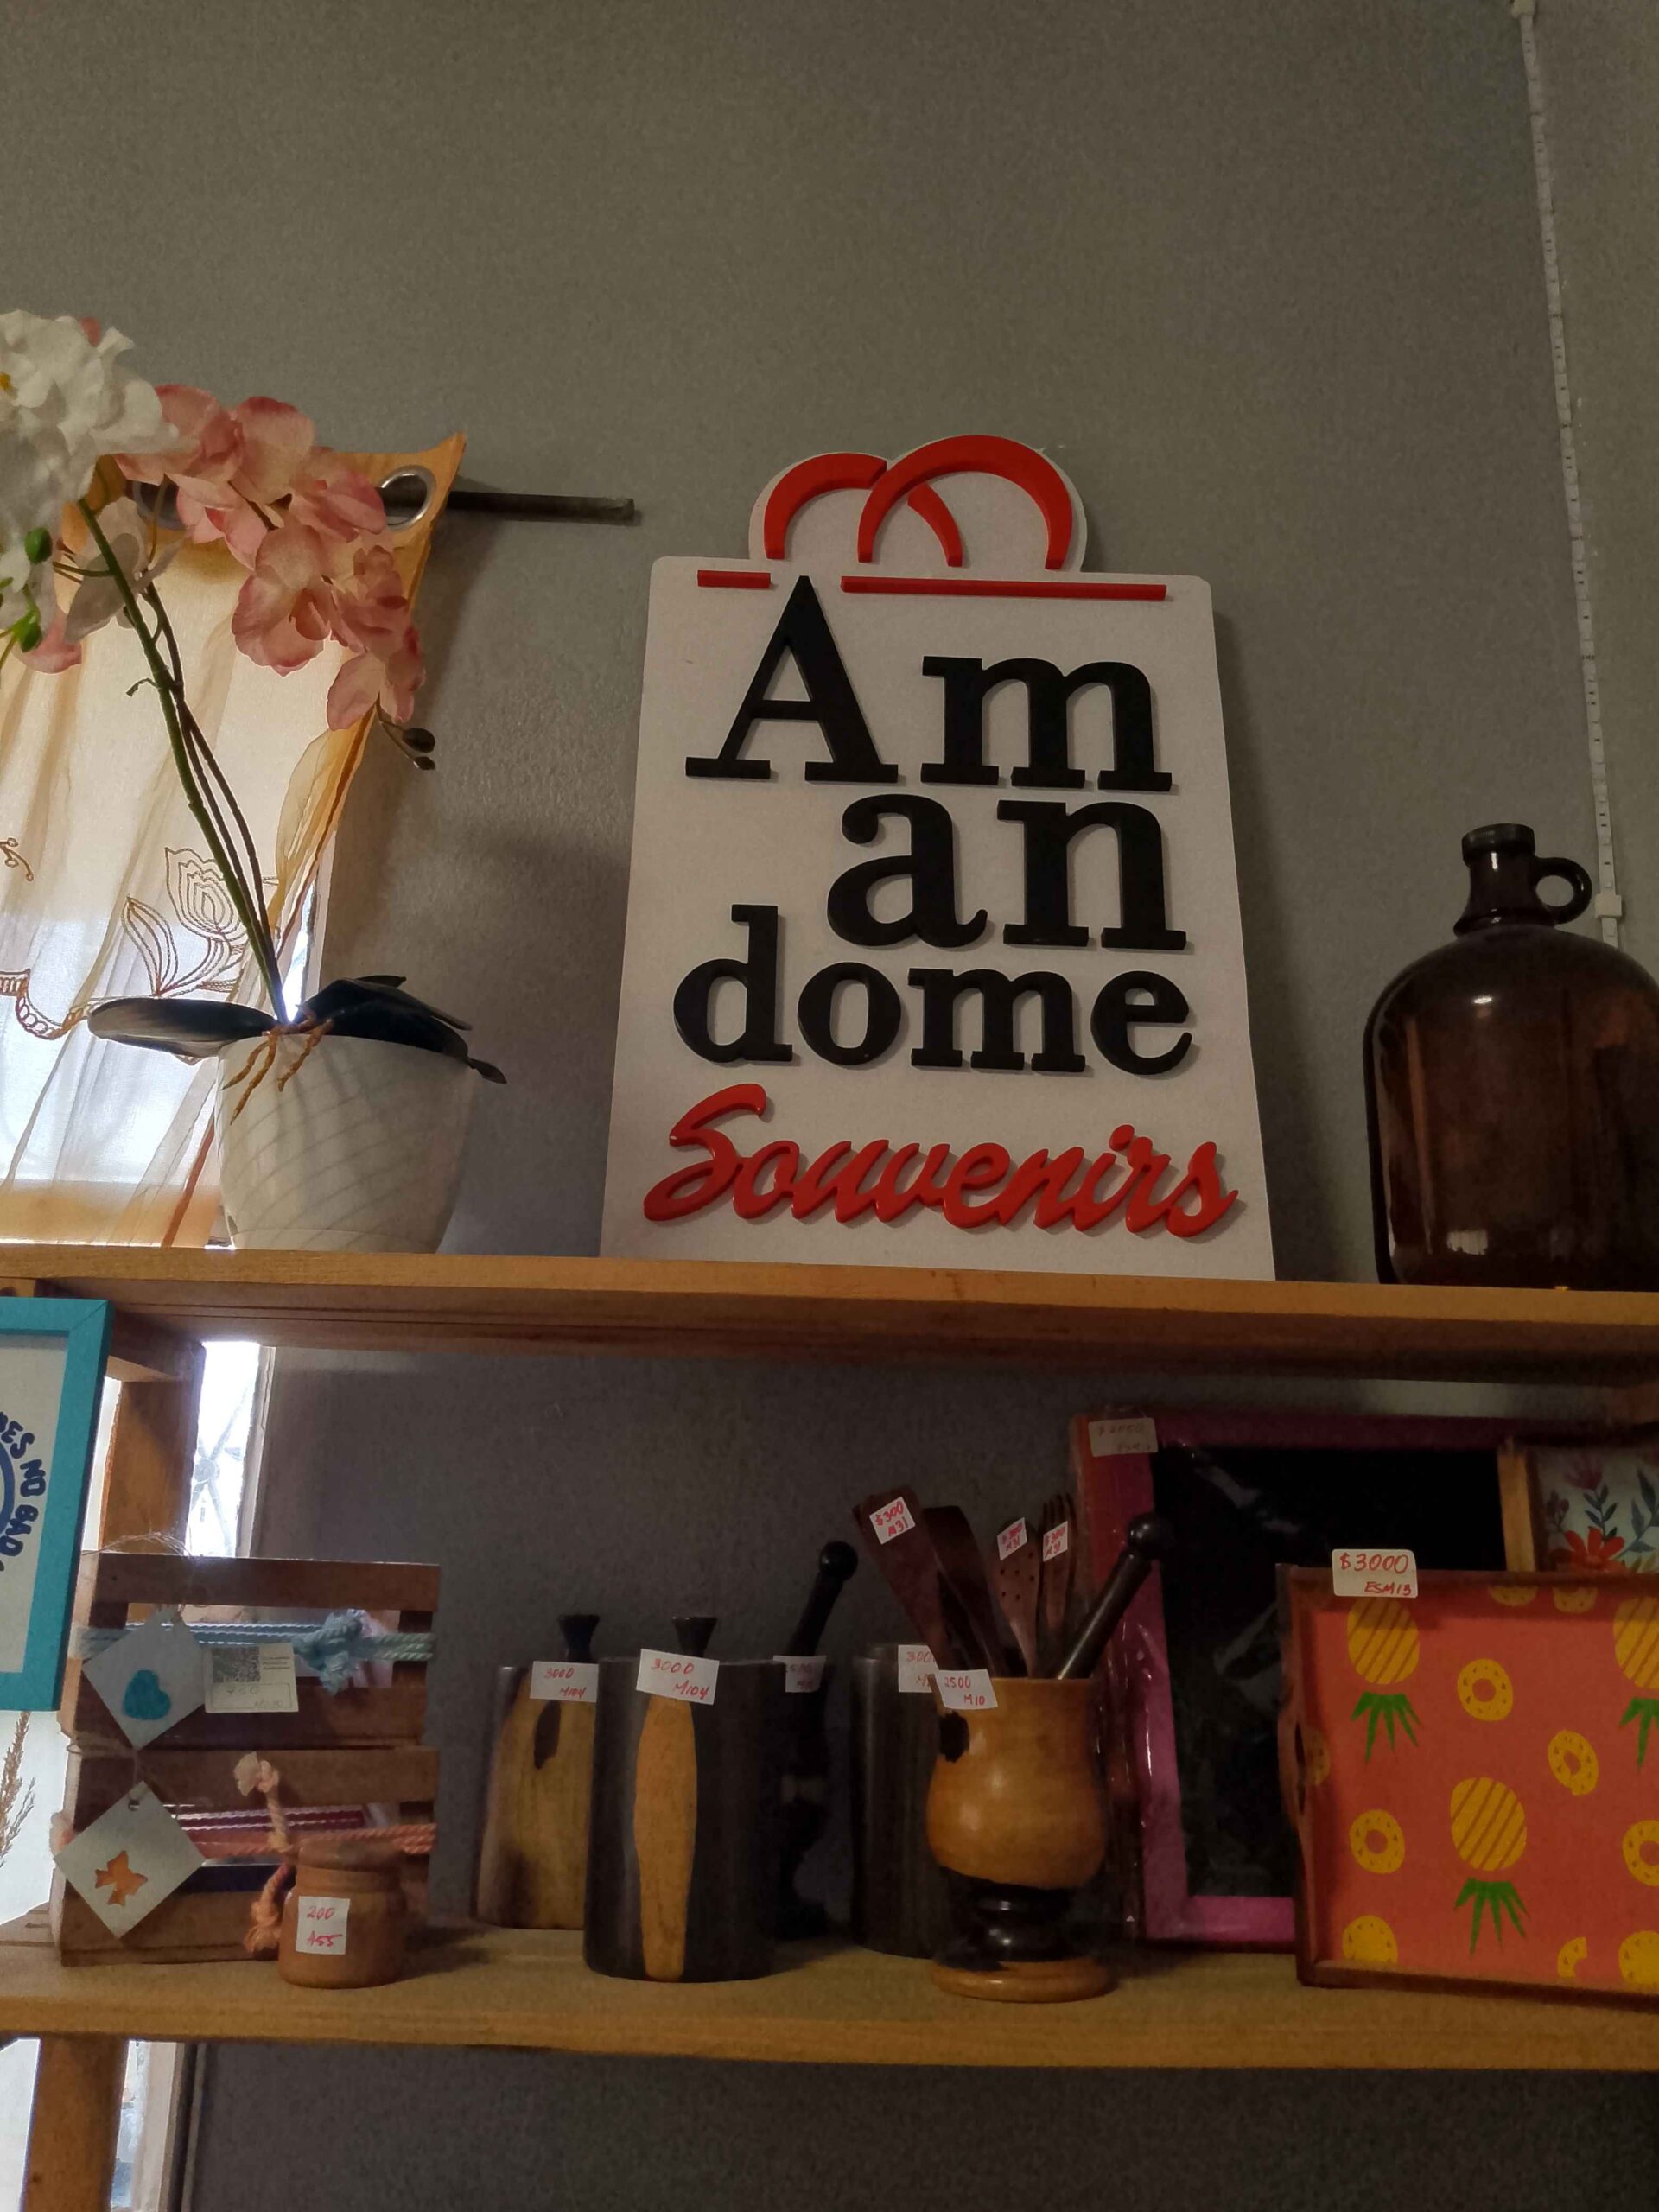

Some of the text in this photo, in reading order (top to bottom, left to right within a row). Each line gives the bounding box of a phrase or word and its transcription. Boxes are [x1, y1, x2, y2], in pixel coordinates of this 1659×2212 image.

[827, 792, 1188, 951] an
[672, 903, 1193, 1076] dome
[643, 1082, 1239, 1238] Souvenirs
[20, 1459, 47, 1497] NO
[0, 1504, 39, 1557] BAD
[1340, 1552, 1409, 1575] $3000
[944, 1675, 971, 1689] 2500
